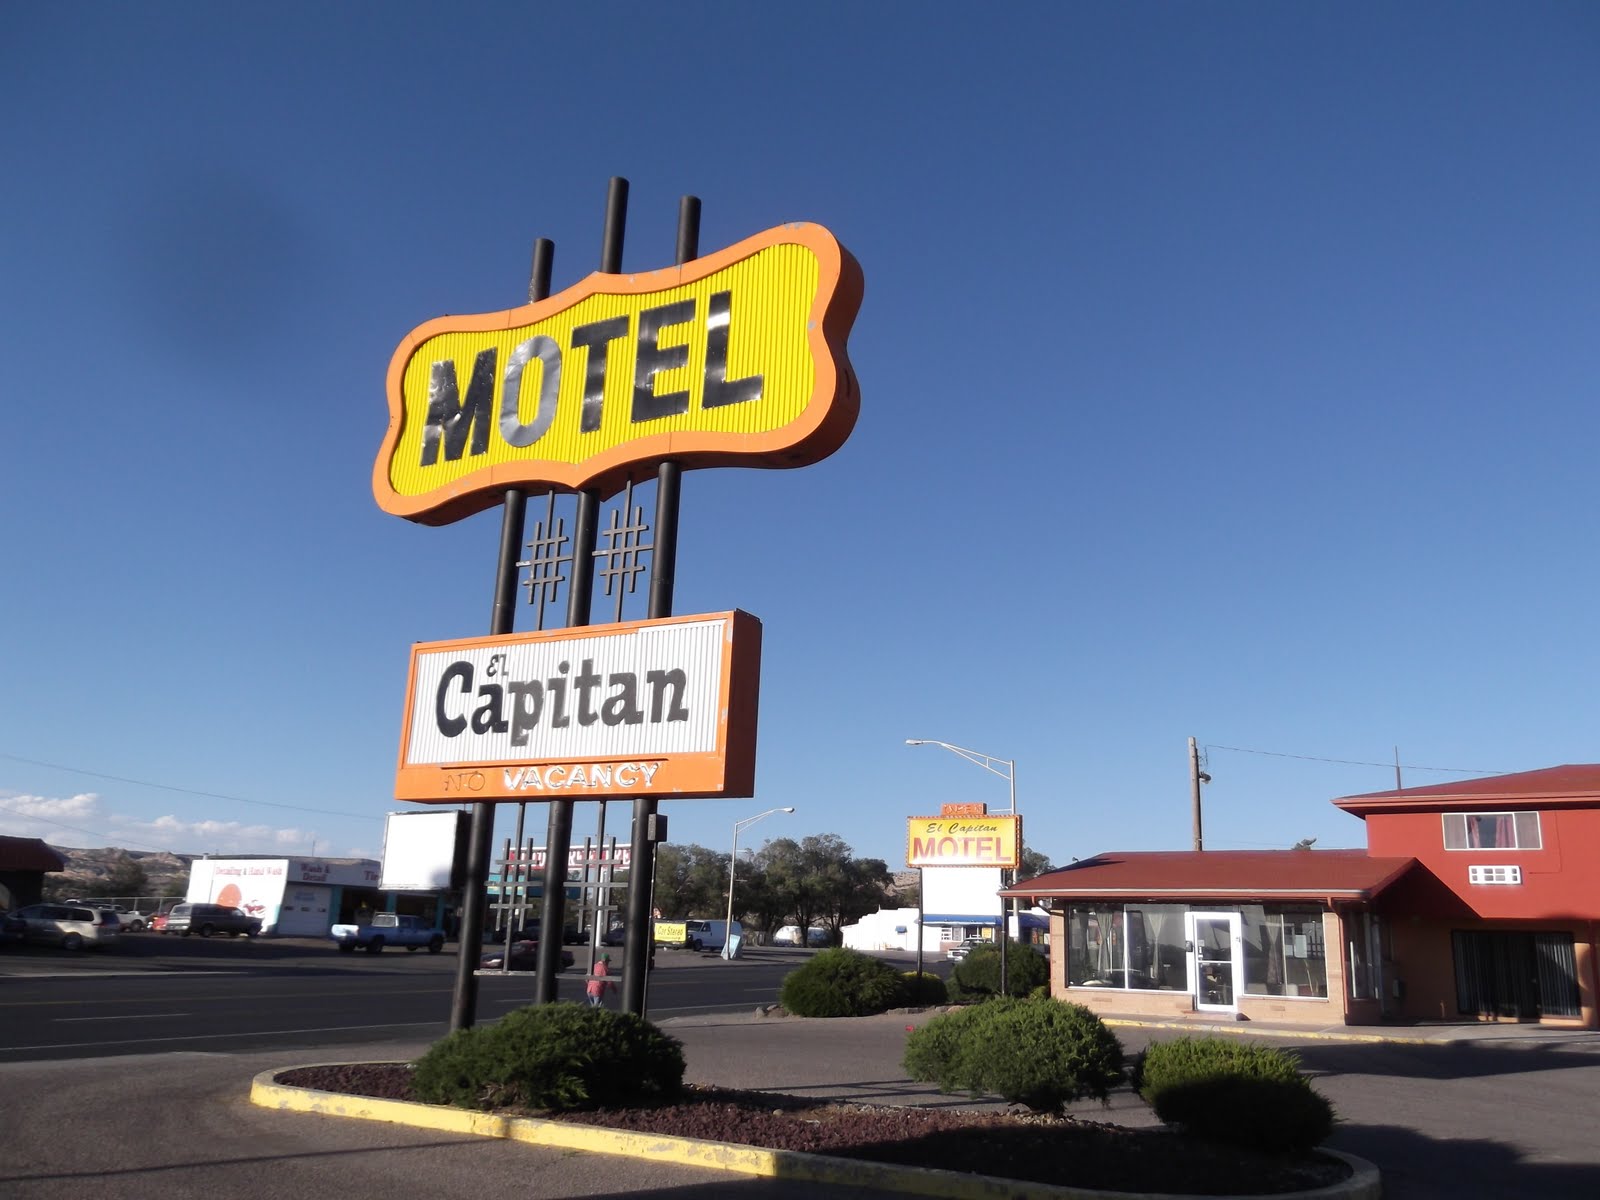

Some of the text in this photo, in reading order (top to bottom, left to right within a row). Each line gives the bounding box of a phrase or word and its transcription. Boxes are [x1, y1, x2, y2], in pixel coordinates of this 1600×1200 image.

[420, 290, 763, 467] MOTEL
[436, 658, 690, 747] Capitan
[443, 762, 660, 792] NO VACANCY
[926, 822, 998, 834] El Capitan
[913, 836, 1012, 862] MOTEL
